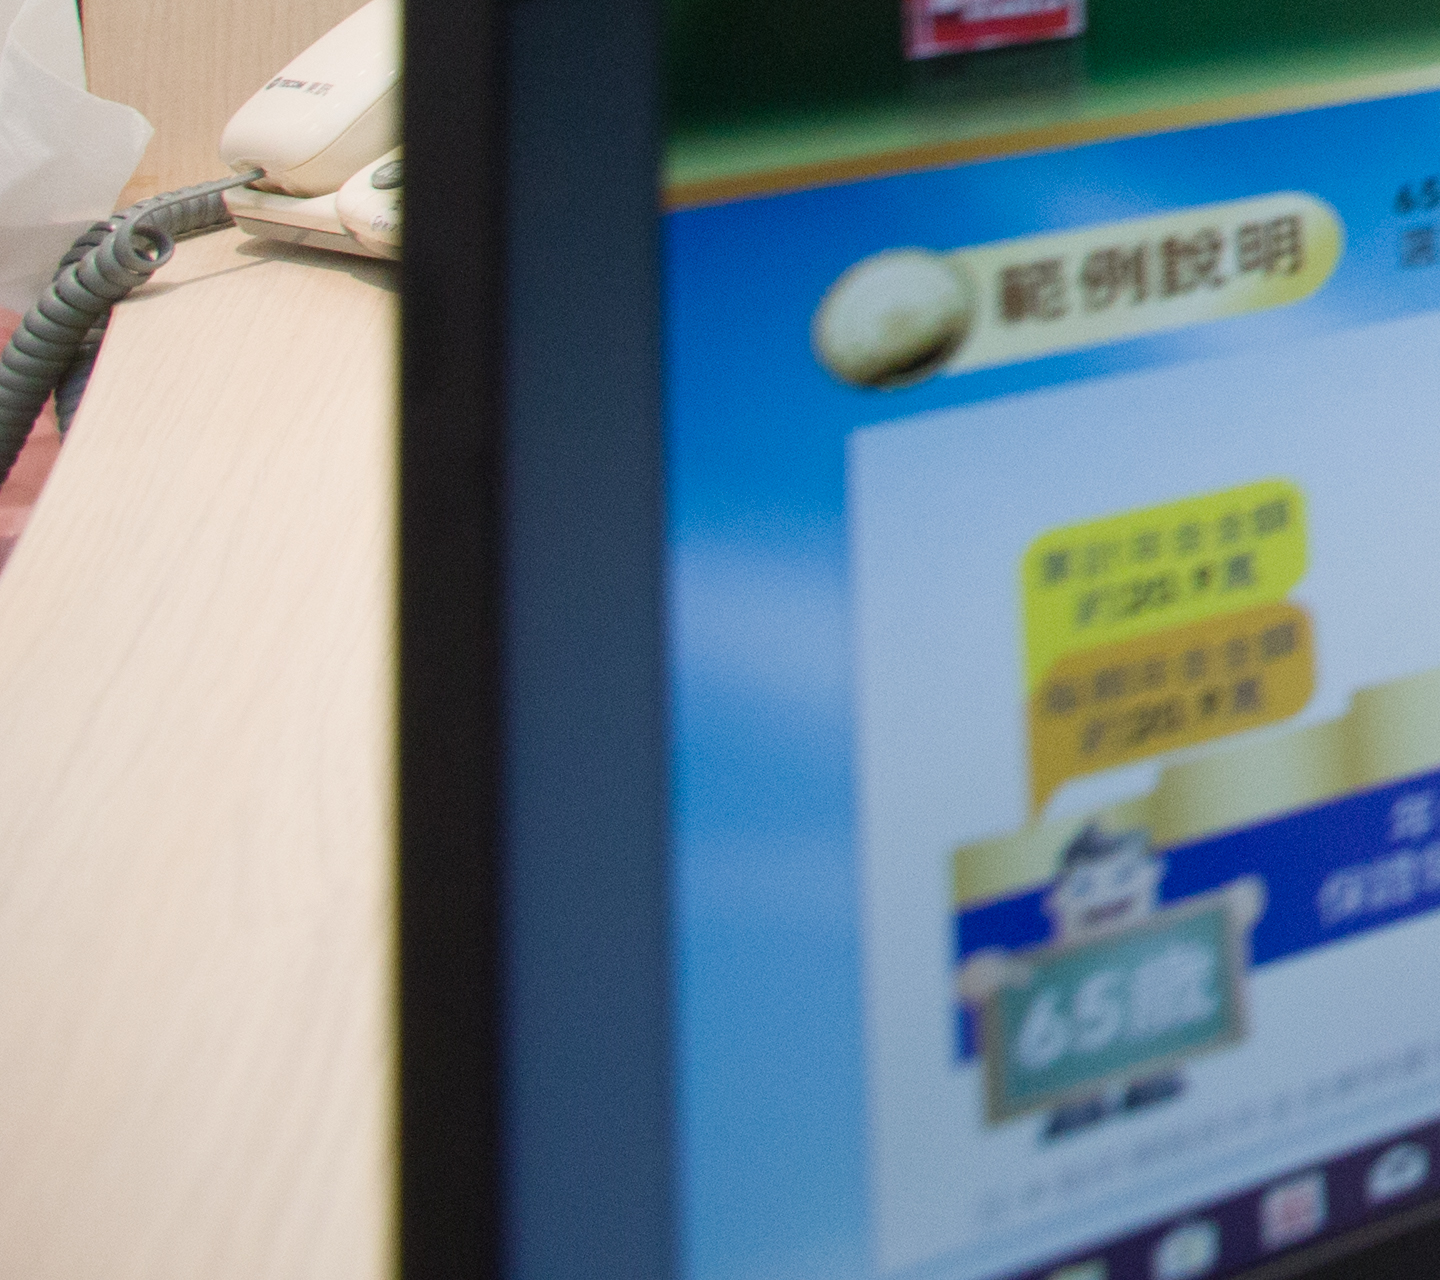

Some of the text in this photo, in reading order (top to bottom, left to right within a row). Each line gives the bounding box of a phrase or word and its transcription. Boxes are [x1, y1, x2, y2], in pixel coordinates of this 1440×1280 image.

[993, 211, 1306, 327] 範例說明
[1013, 942, 1222, 1072] 65歲
